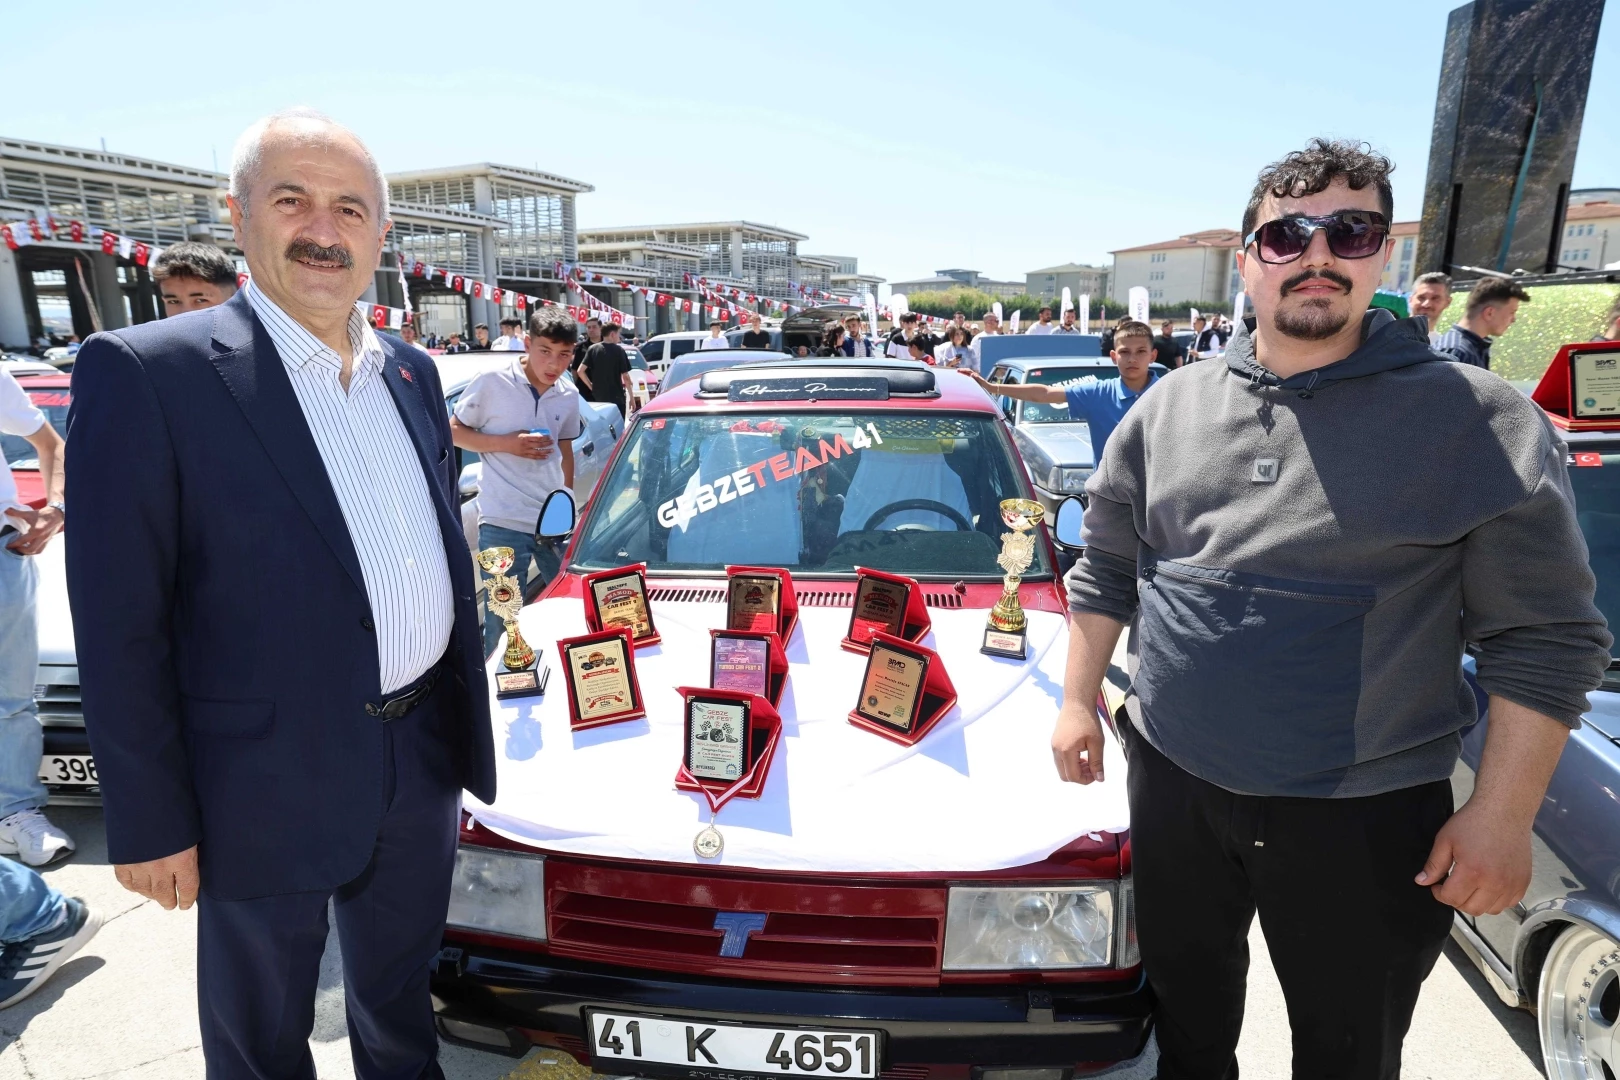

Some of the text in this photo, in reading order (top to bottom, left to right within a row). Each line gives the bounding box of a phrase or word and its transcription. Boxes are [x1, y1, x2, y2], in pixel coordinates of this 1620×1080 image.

[707, 709, 729, 717] GEBZE
[598, 1018, 871, 1075] 41 K 4651
